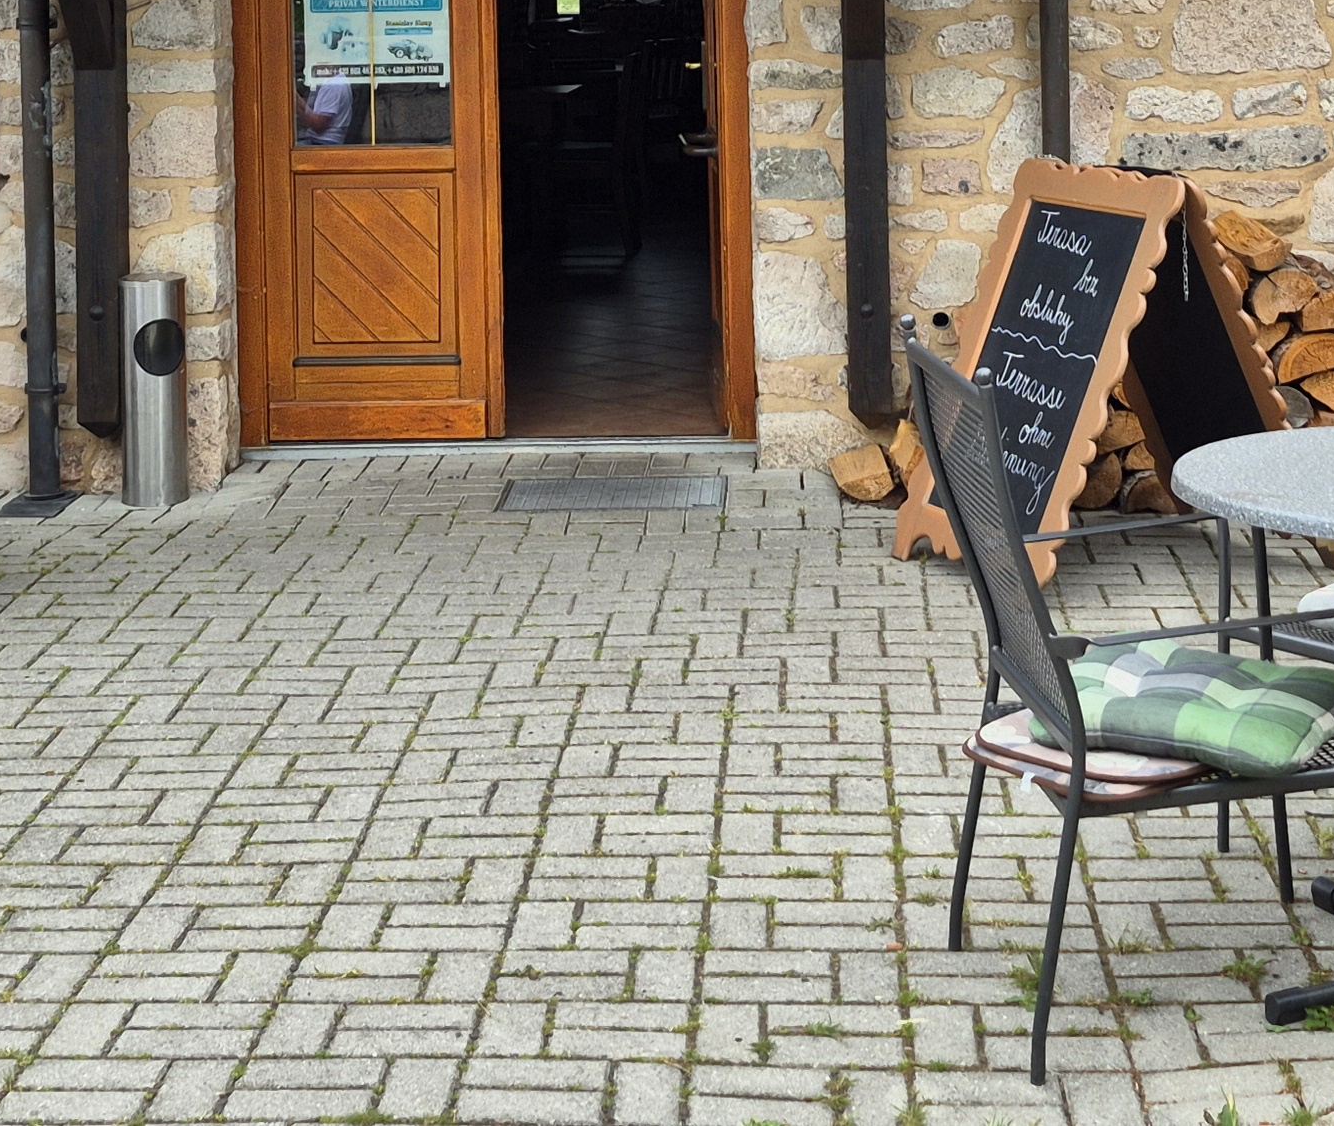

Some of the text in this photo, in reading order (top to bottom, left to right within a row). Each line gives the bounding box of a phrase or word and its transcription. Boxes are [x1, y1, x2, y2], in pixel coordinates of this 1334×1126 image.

[1037, 210, 1092, 256] Terasa
[1073, 258, 1099, 298] bez
[1020, 283, 1074, 346] obsluhy
[996, 351, 1067, 410] Terrasse
[1018, 411, 1056, 449] ohne
